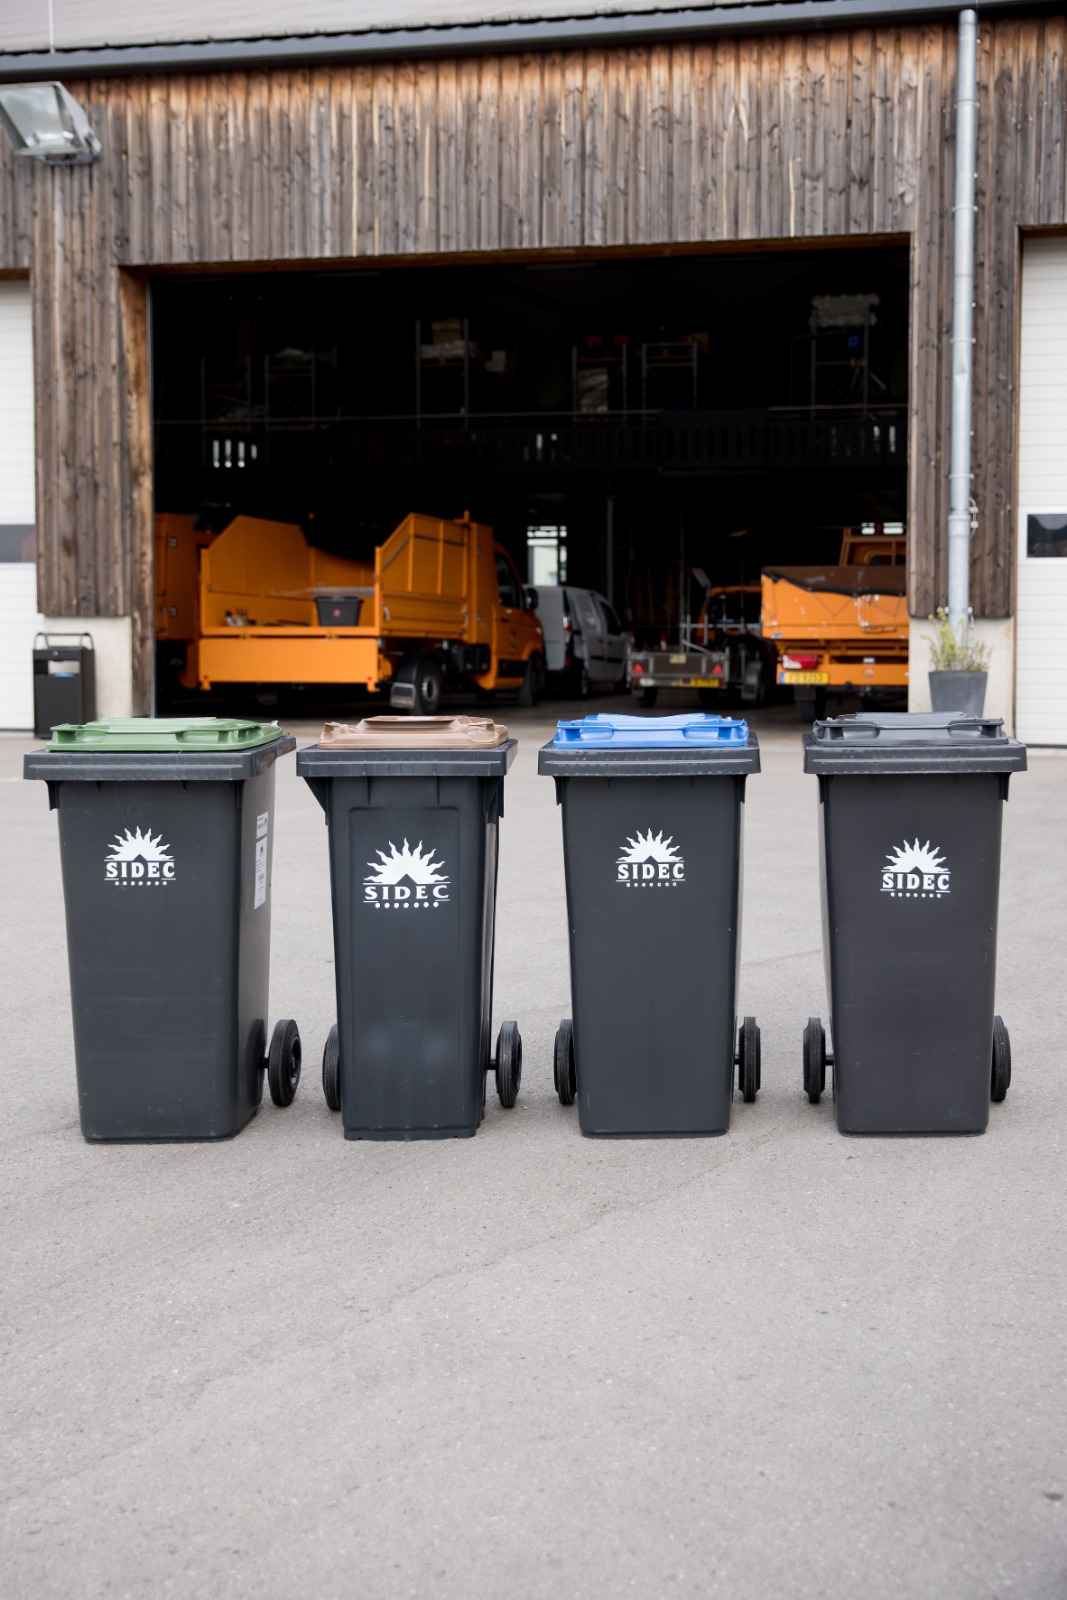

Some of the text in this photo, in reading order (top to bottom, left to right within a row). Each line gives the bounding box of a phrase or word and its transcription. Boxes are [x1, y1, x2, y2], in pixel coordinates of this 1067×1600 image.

[106, 862, 175, 878] SIDEC
[617, 863, 684, 880] SIDEC
[882, 873, 950, 890] SIDEC
[364, 885, 449, 900] SIDEC
